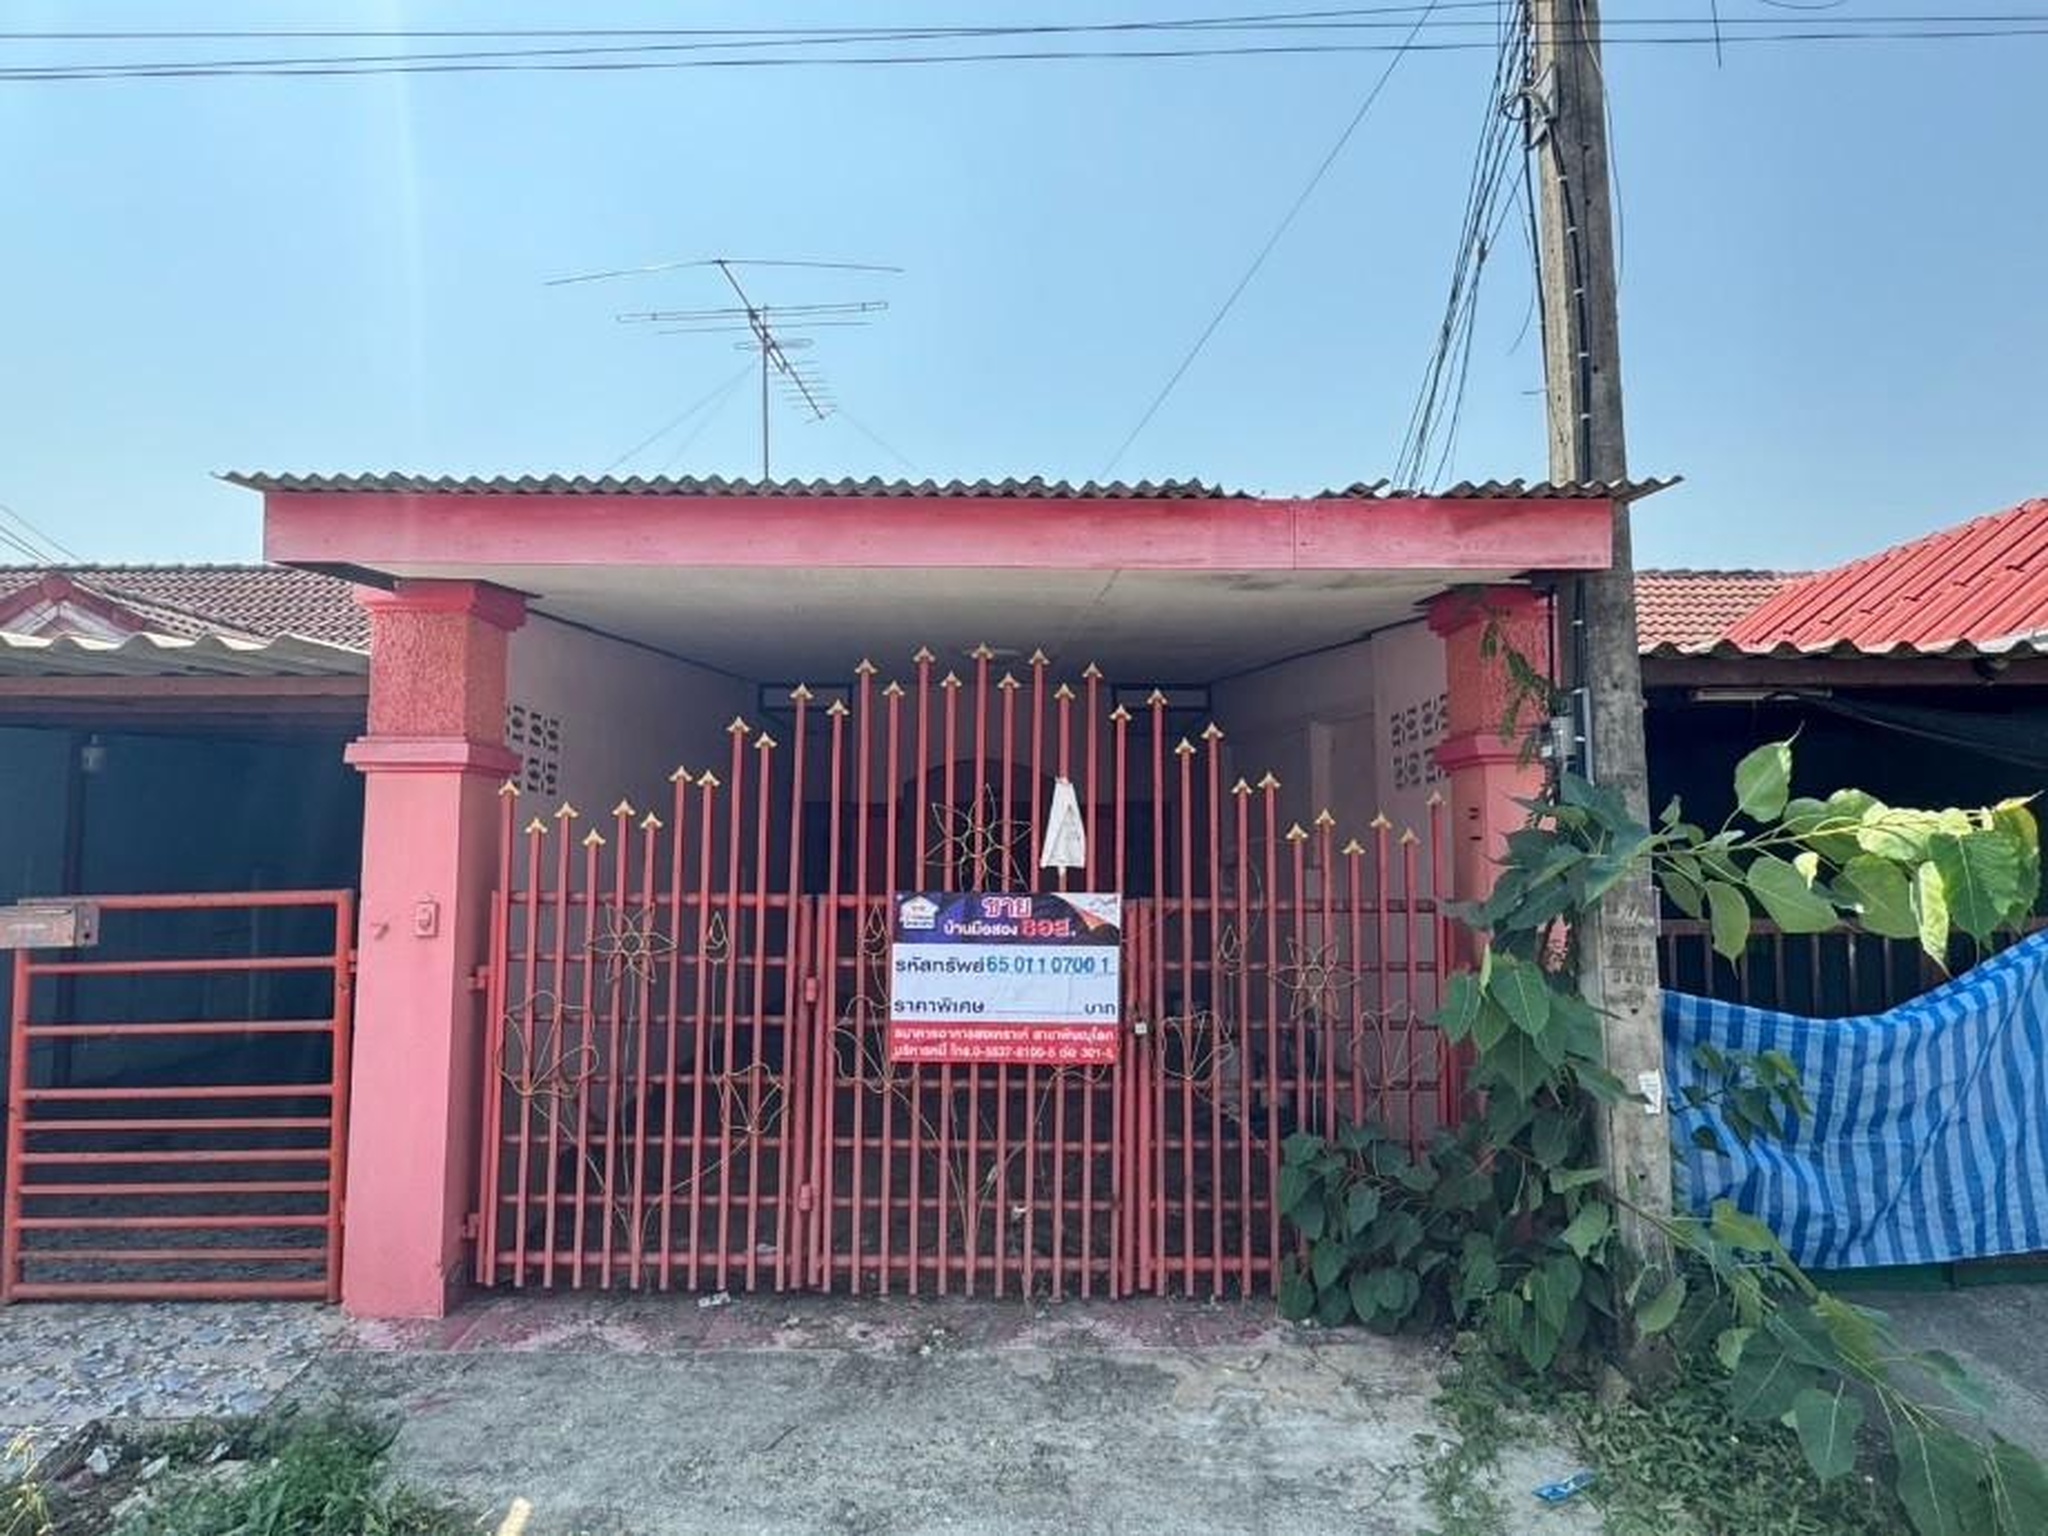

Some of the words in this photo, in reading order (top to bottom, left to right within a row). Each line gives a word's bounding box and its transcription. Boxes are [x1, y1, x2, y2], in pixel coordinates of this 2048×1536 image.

[982, 897, 1031, 918] ขาย
[944, 920, 1018, 936] บ้านมือสอง
[894, 997, 985, 1014] ราคาพิเศษ
[1085, 1004, 1115, 1016] บาท
